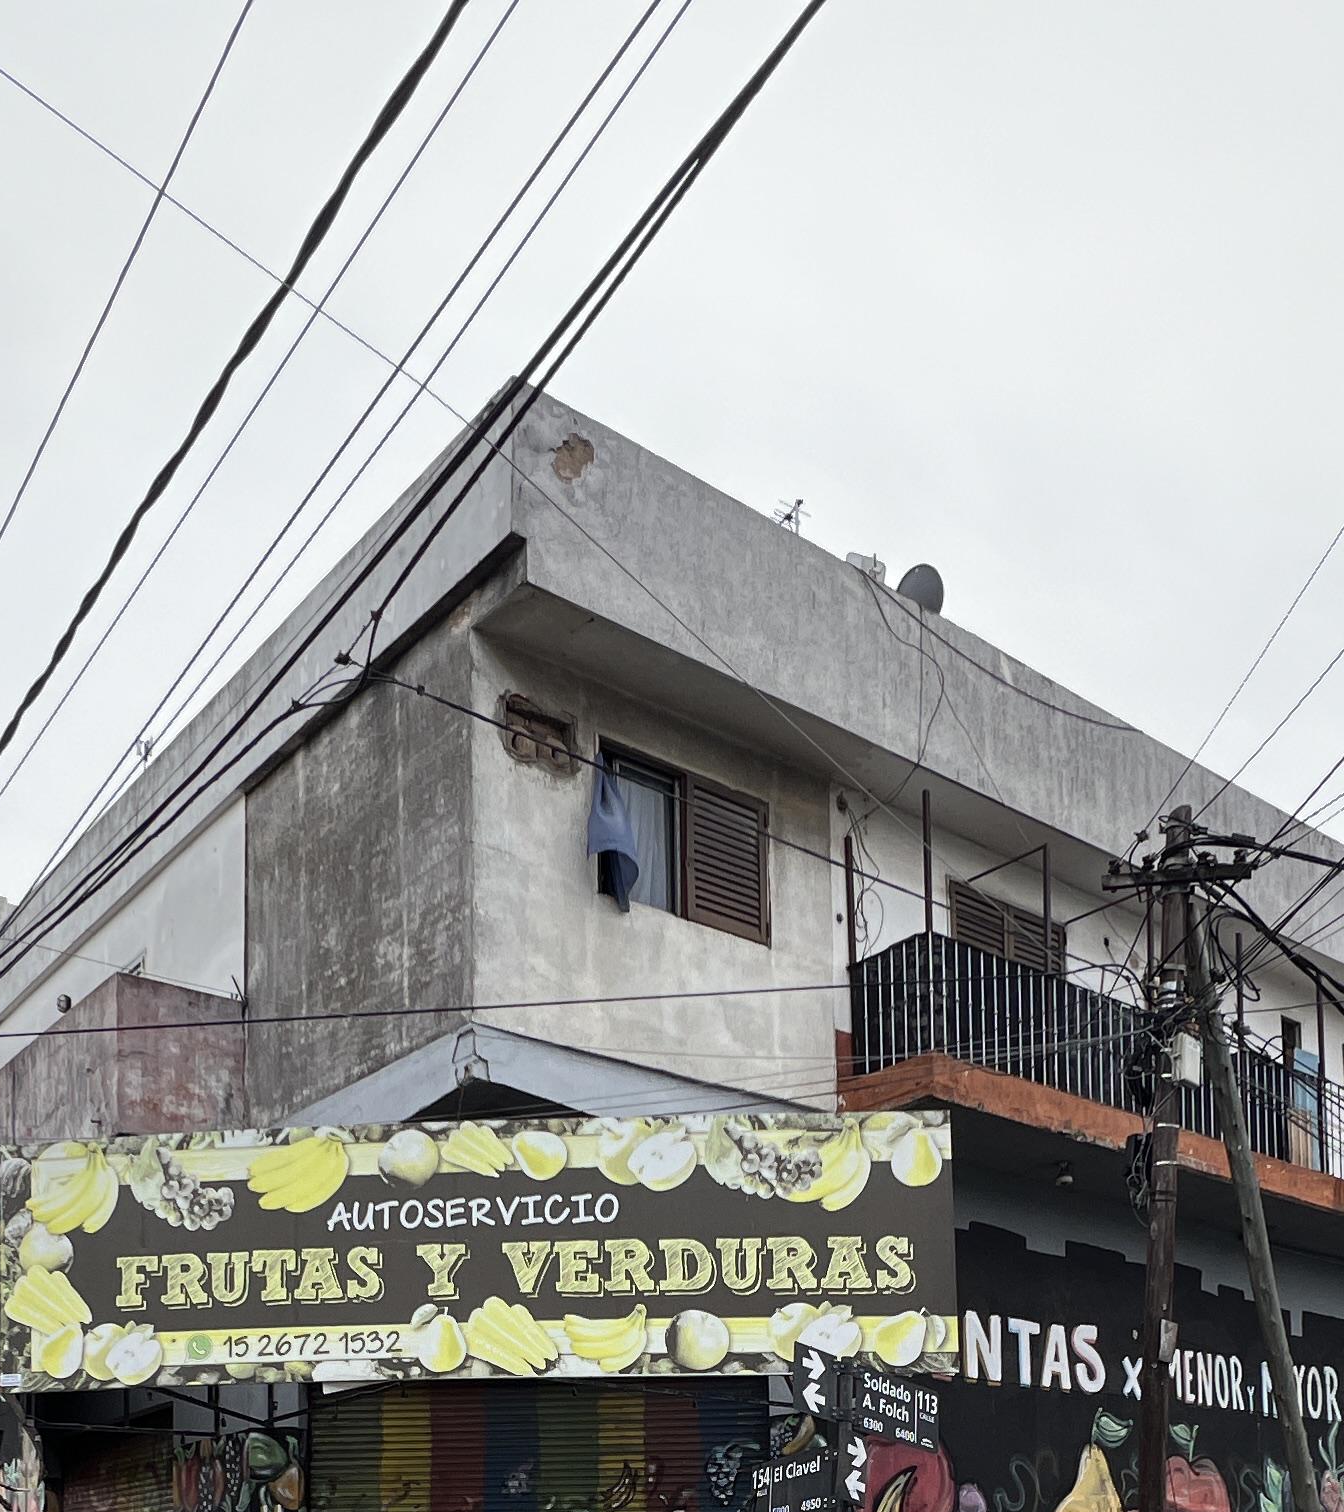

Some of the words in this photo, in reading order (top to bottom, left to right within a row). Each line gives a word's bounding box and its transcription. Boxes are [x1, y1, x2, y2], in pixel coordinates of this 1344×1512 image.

[327, 1193, 619, 1231] AUTOSERVICIO
[115, 1246, 385, 1311] FRUTAS
[416, 1243, 470, 1301] Y
[501, 1234, 917, 1297] VERDURAS
[223, 1335, 249, 1358] 15
[258, 1332, 330, 1356] 2672
[339, 1330, 403, 1355] 1532
[962, 1309, 1107, 1395] NTAS
[863, 1372, 911, 1403] Soldado
[862, 1393, 876, 1411] A.
[879, 1398, 909, 1423] Folch
[917, 1390, 938, 1415] 113
[863, 1417, 884, 1433] 6300
[895, 1427, 915, 1443] 6400
[752, 1466, 770, 1490] 154
[774, 1465, 783, 1483] El
[785, 1455, 821, 1479] Clavel
[800, 1497, 822, 1512] 4950
